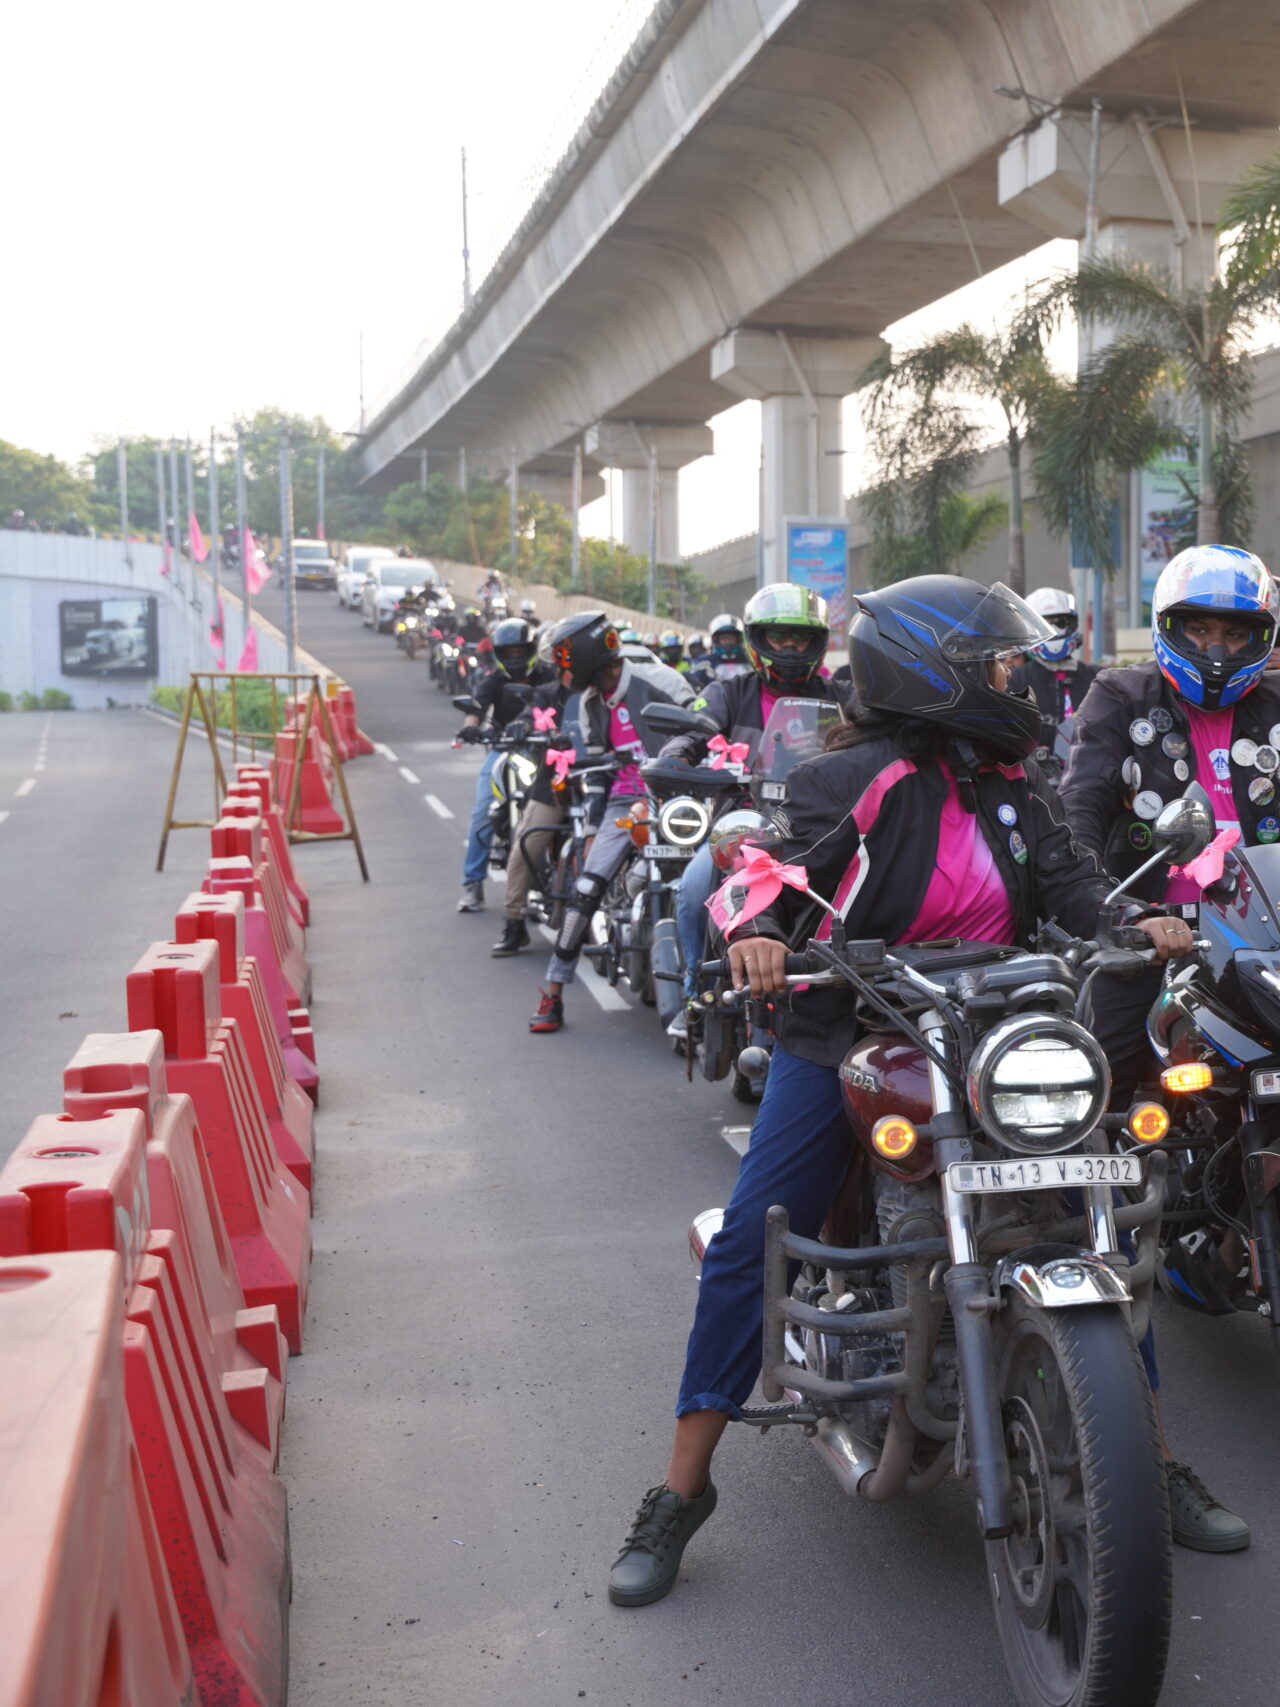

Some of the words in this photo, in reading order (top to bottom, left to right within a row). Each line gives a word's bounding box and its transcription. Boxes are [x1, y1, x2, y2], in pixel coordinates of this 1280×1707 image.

[976, 1165, 1002, 1188] TN
[1017, 1162, 1042, 1185] 13
[1056, 1160, 1067, 1182] V
[1083, 1158, 1134, 1182] 3202
